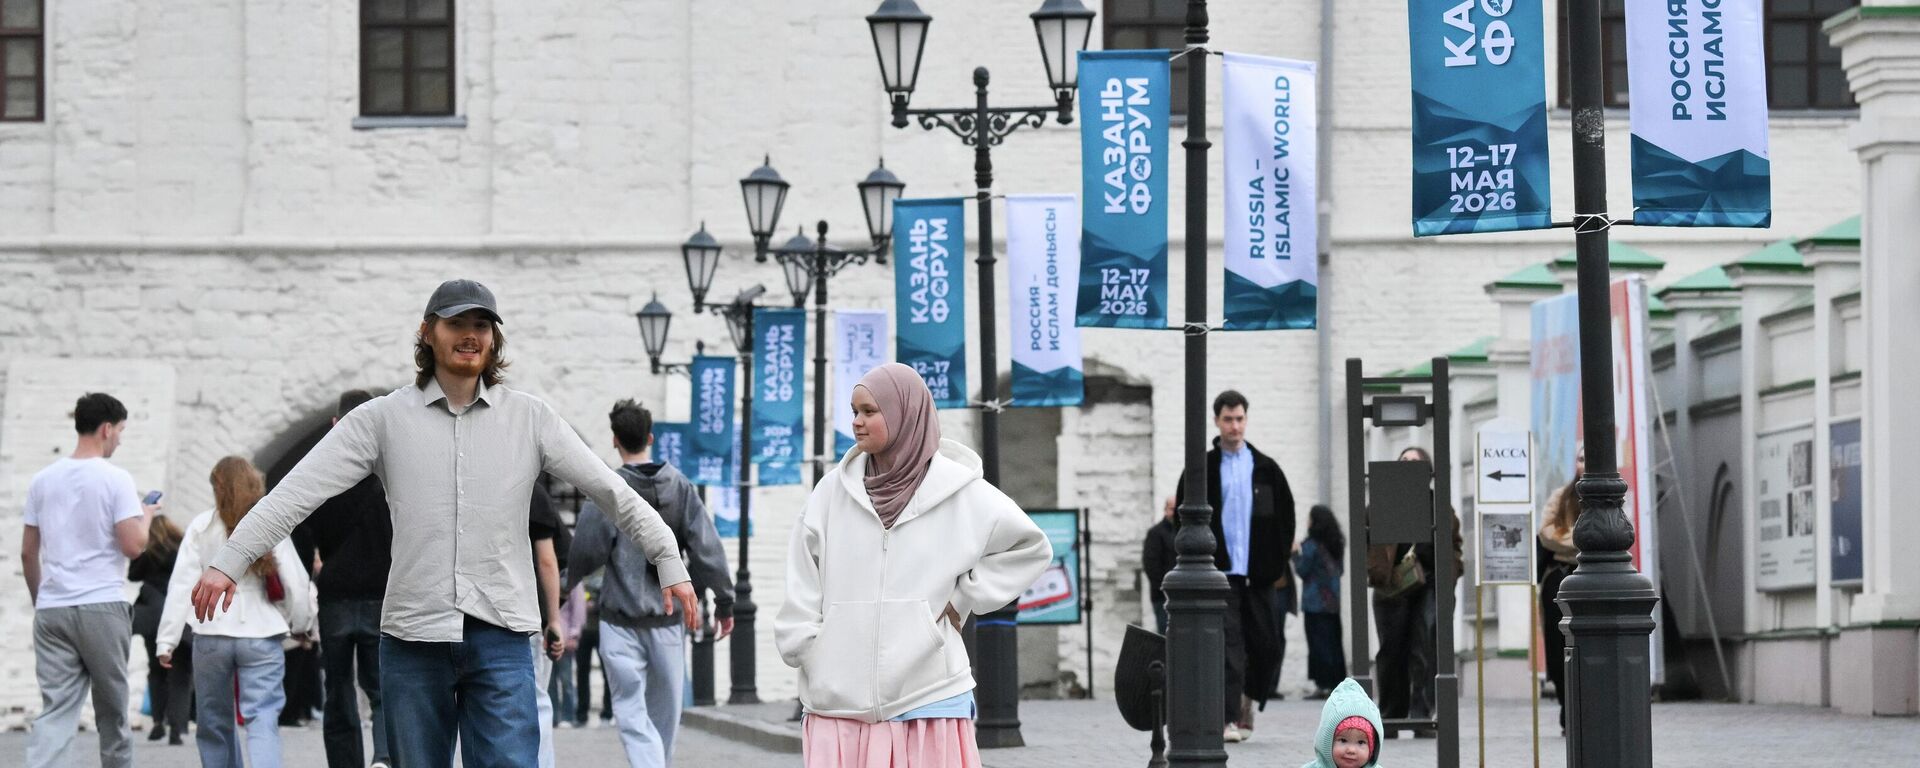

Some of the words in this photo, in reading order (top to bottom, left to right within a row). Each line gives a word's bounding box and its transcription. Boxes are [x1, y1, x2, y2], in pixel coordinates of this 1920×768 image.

[1443, 0, 1476, 67] КА
[1667, 0, 1692, 120] РОССИЯ
[1100, 77, 1127, 214] КАЗАНЬ
[1126, 77, 1152, 215] ФОРУМ
[1274, 75, 1290, 160] WORLD
[1447, 144, 1517, 168] 12–17
[1451, 169, 1514, 192] МАЯ
[1249, 176, 1265, 259] RUSSIA
[1275, 167, 1291, 261] ISLAMIC
[1450, 191, 1516, 213] 2026
[910, 218, 929, 324] КАЗАНЬ
[929, 218, 950, 323] ФОРУМ
[1100, 285, 1149, 300] MAY
[1101, 268, 1150, 284] 12–17
[1029, 286, 1042, 351] РОССИЯ
[1047, 293, 1060, 351] ИСЛАМ
[1100, 300, 1148, 315] 2026
[763, 325, 780, 402] КАЗАНЬ
[779, 324, 795, 402] ФОРУМ
[924, 374, 949, 387] АЙ
[932, 388, 949, 399] 26
[1483, 448, 1527, 458] КАССА
